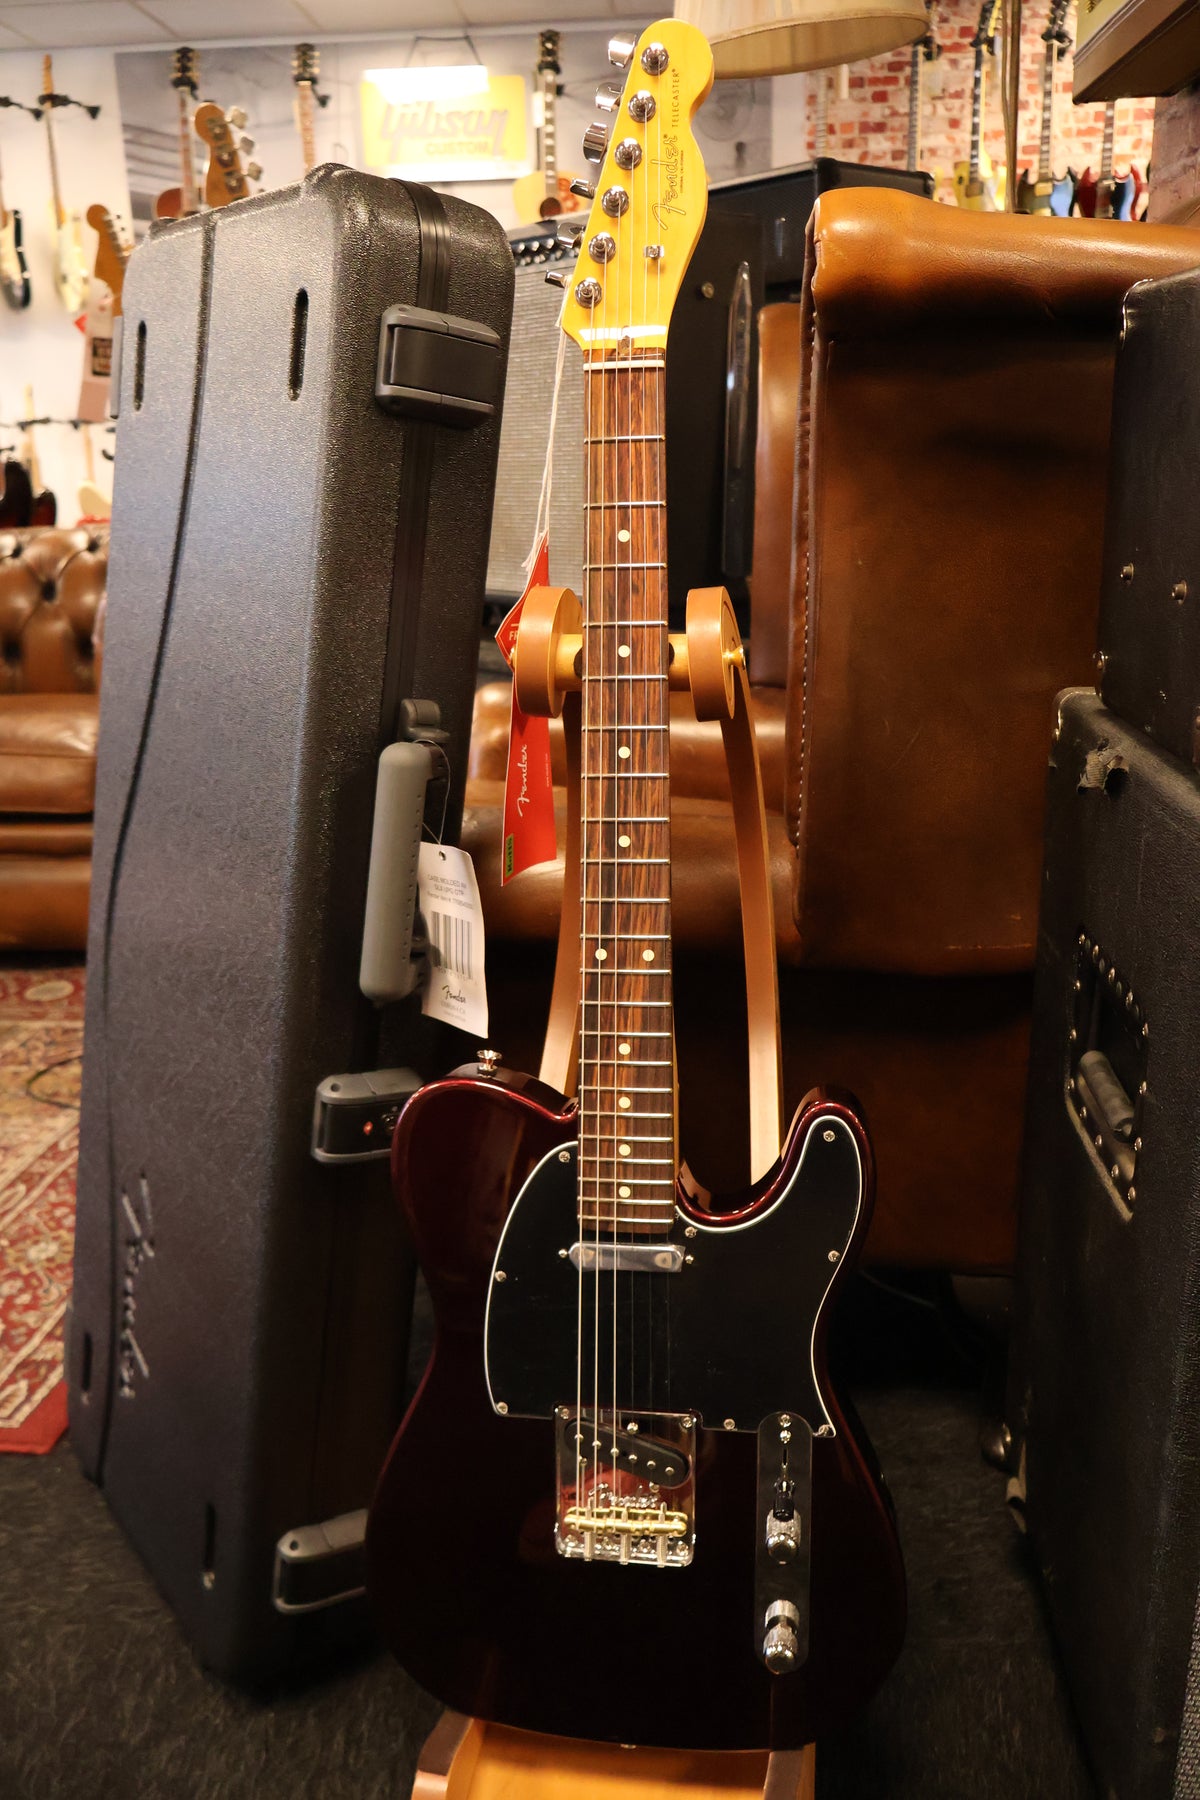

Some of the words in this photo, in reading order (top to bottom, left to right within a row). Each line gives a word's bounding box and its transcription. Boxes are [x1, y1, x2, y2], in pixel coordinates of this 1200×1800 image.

[381, 101, 508, 163] Gibson
[425, 141, 489, 155] CUSTOM
[517, 744, 529, 817] Fender
[442, 984, 466, 1004] Fender
